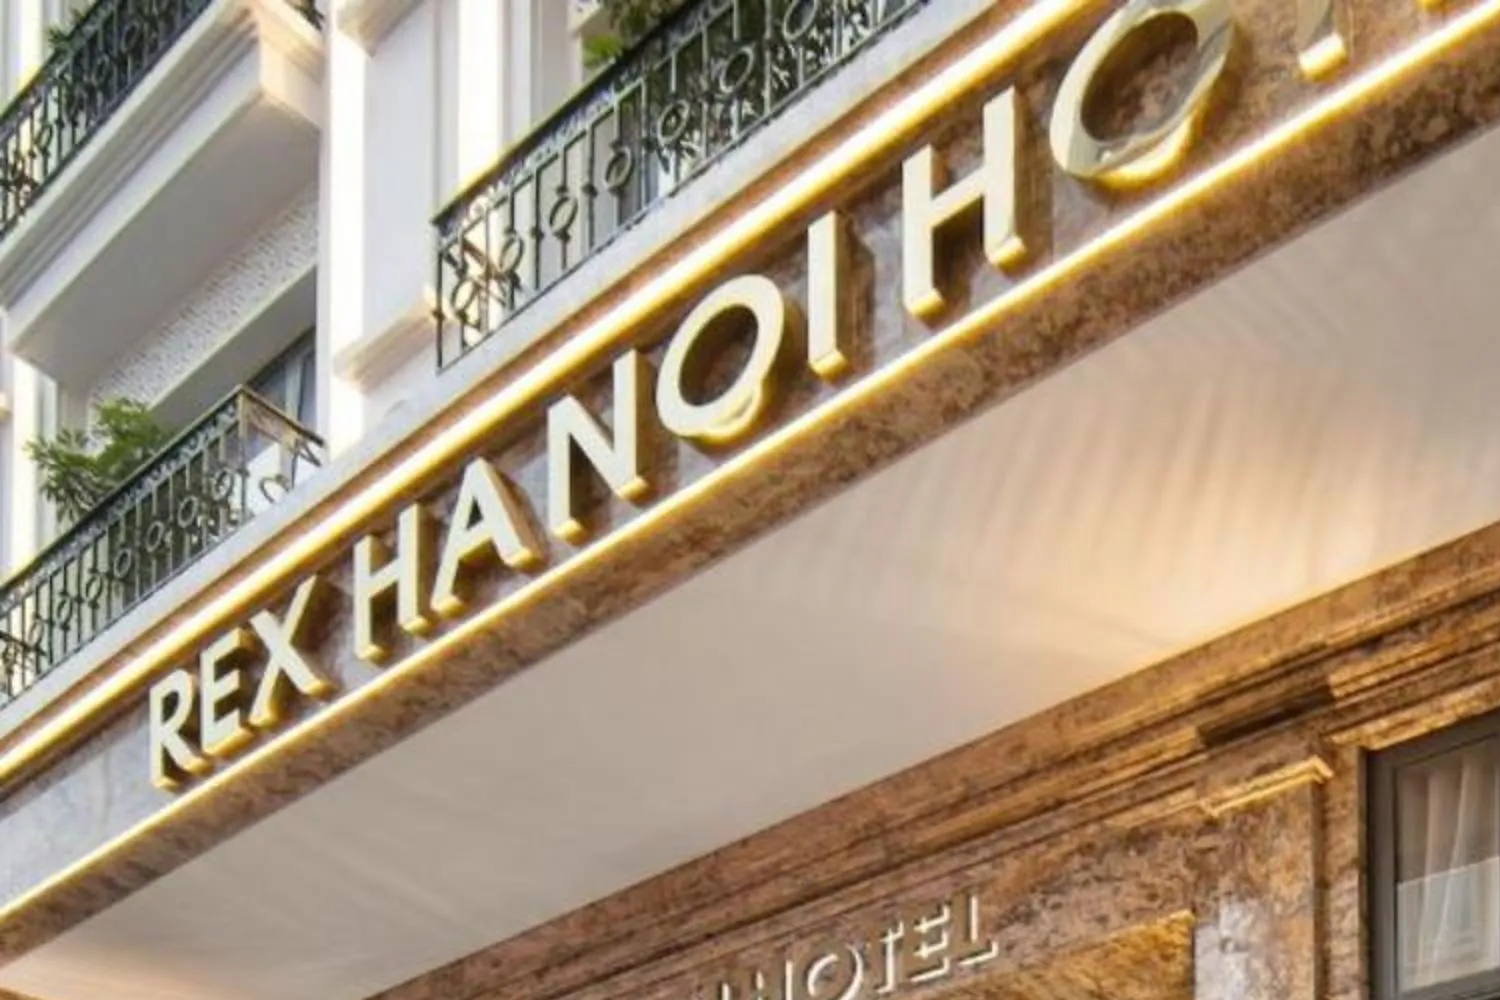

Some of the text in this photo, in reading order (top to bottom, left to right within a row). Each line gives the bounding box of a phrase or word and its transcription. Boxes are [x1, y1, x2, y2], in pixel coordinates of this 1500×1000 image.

[150, 0, 1445, 790] REX HANOI HO
